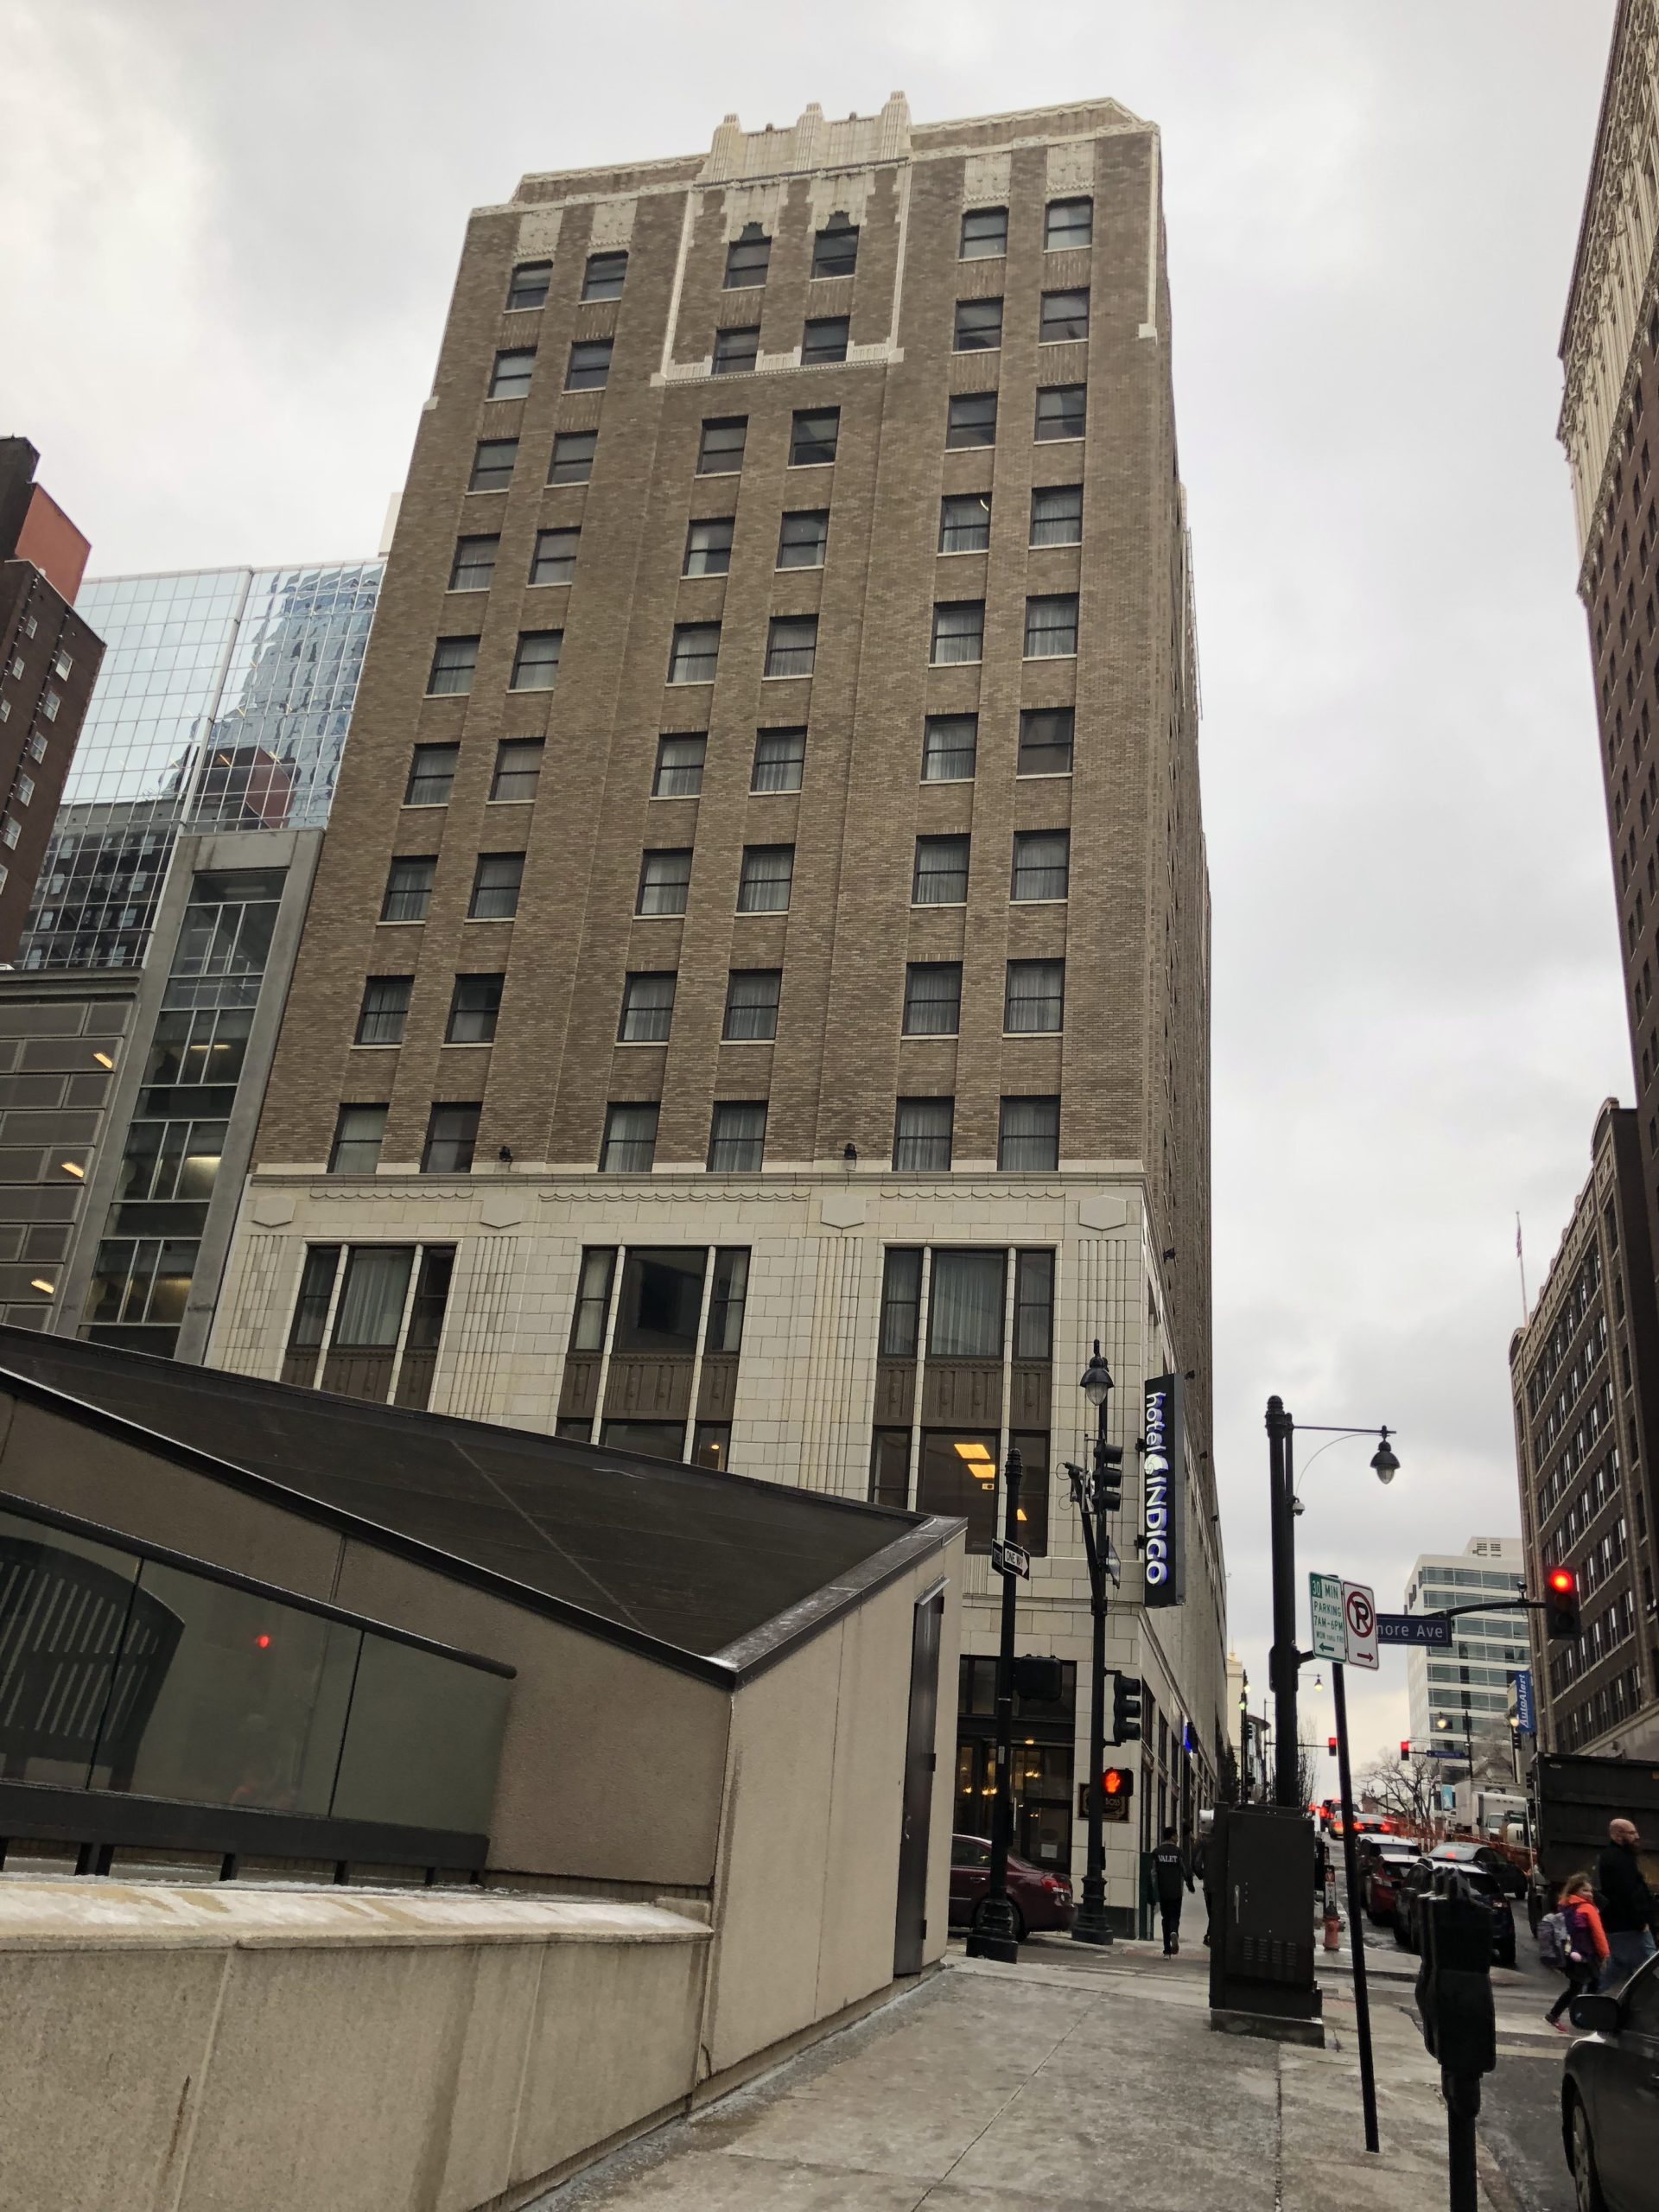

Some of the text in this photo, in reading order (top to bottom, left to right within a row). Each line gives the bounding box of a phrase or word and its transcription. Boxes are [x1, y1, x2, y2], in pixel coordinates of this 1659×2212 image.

[1146, 1391, 1167, 1586] hotel INDIGO
[1007, 1550, 1015, 1564] ONE
[1312, 1580, 1338, 1599] 30 MIN
[1313, 1600, 1342, 1618] PARKING
[1313, 1615, 1344, 1631] 7AM-6PM
[1416, 1624, 1443, 1638] Ave
[1518, 1674, 1529, 1729] AutoAlert
[1158, 1854, 1178, 1863] VALET
